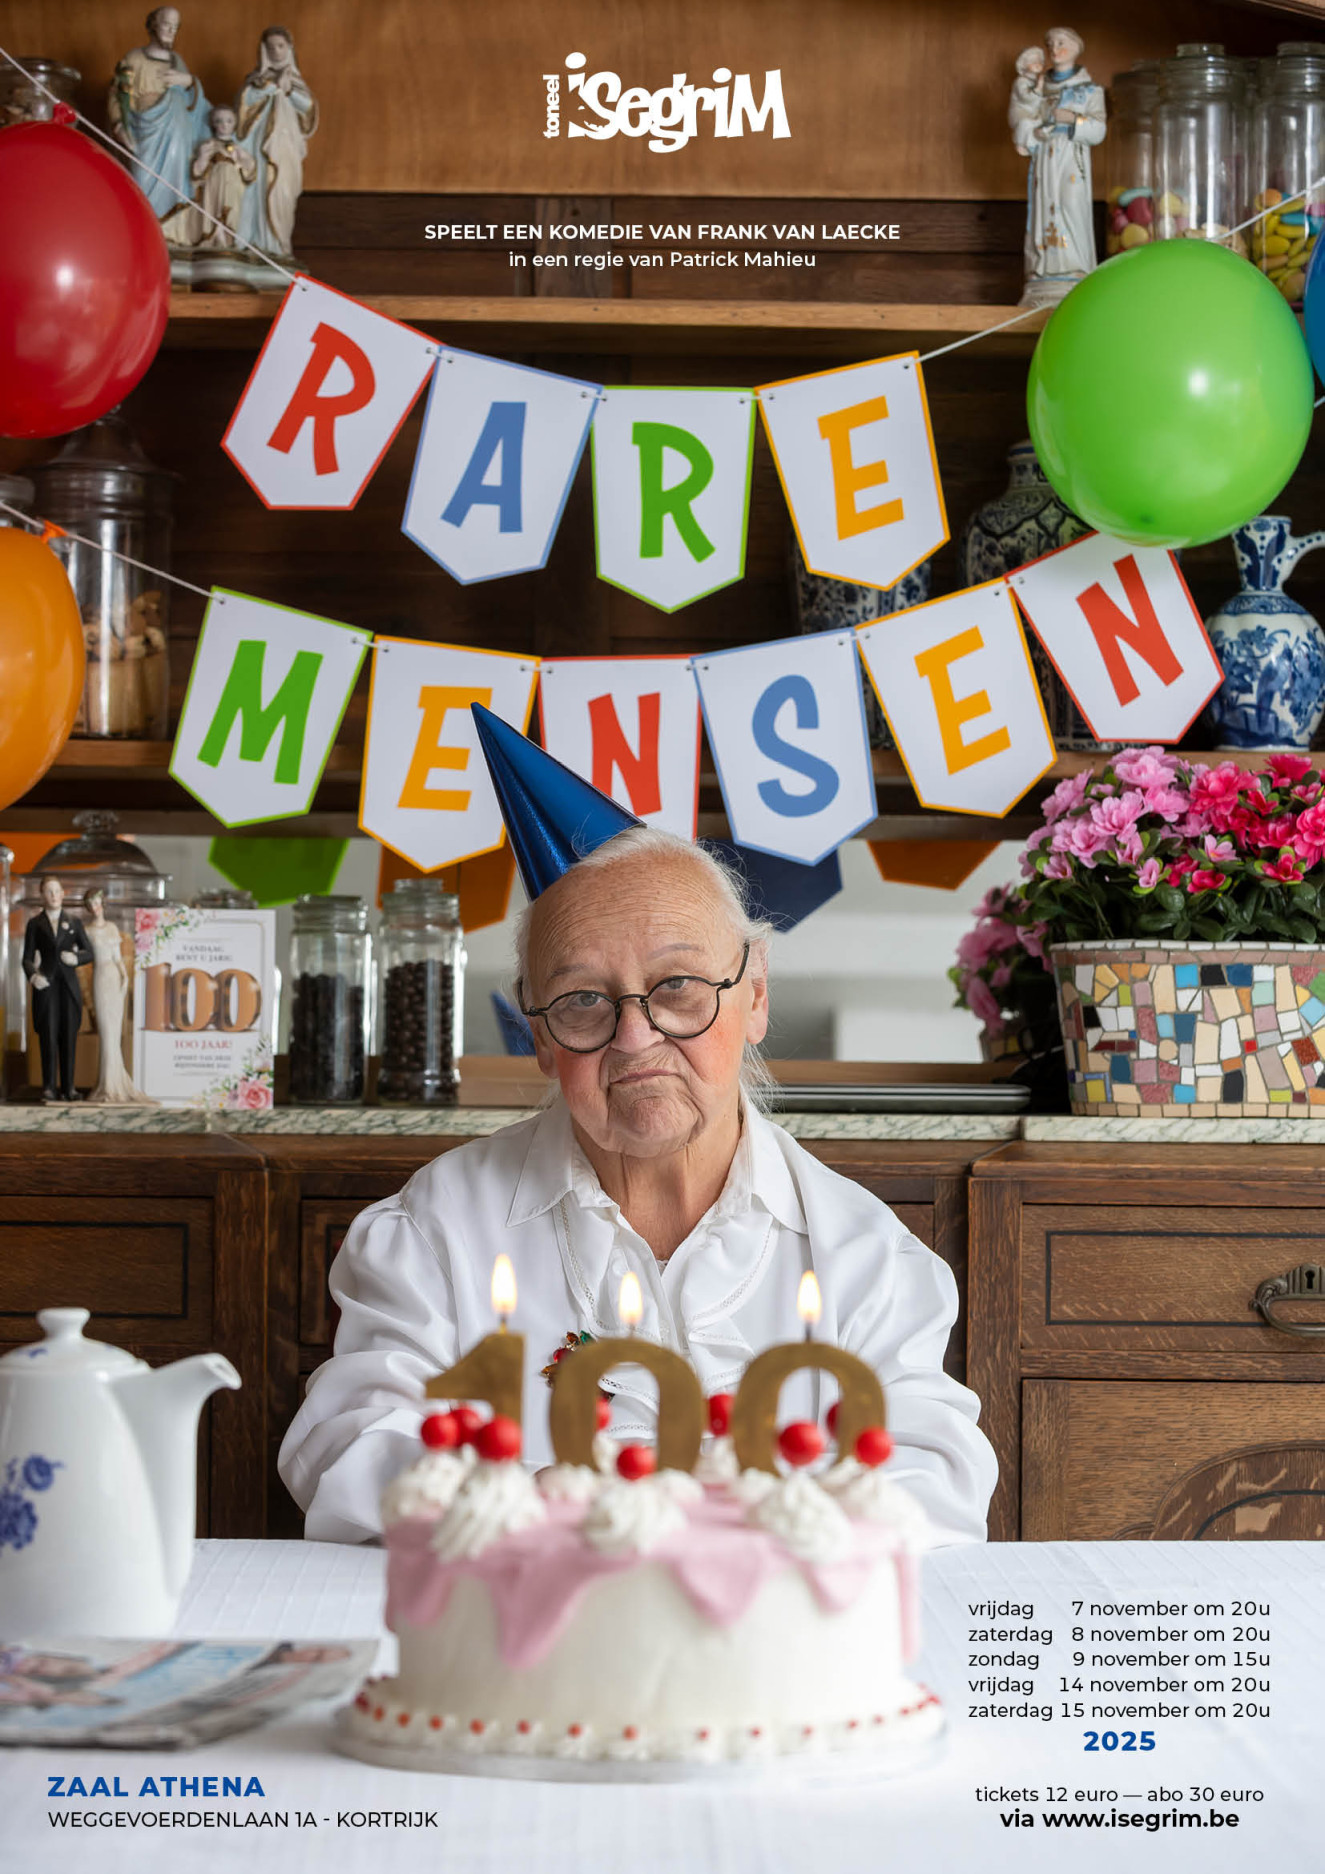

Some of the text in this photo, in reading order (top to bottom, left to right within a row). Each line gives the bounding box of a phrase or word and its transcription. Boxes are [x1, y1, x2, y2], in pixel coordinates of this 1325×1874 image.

[267, 322, 904, 562] RARE
[199, 554, 1184, 817] MENSEN
[141, 962, 262, 1032] 100
[426, 1333, 886, 1475] 100
